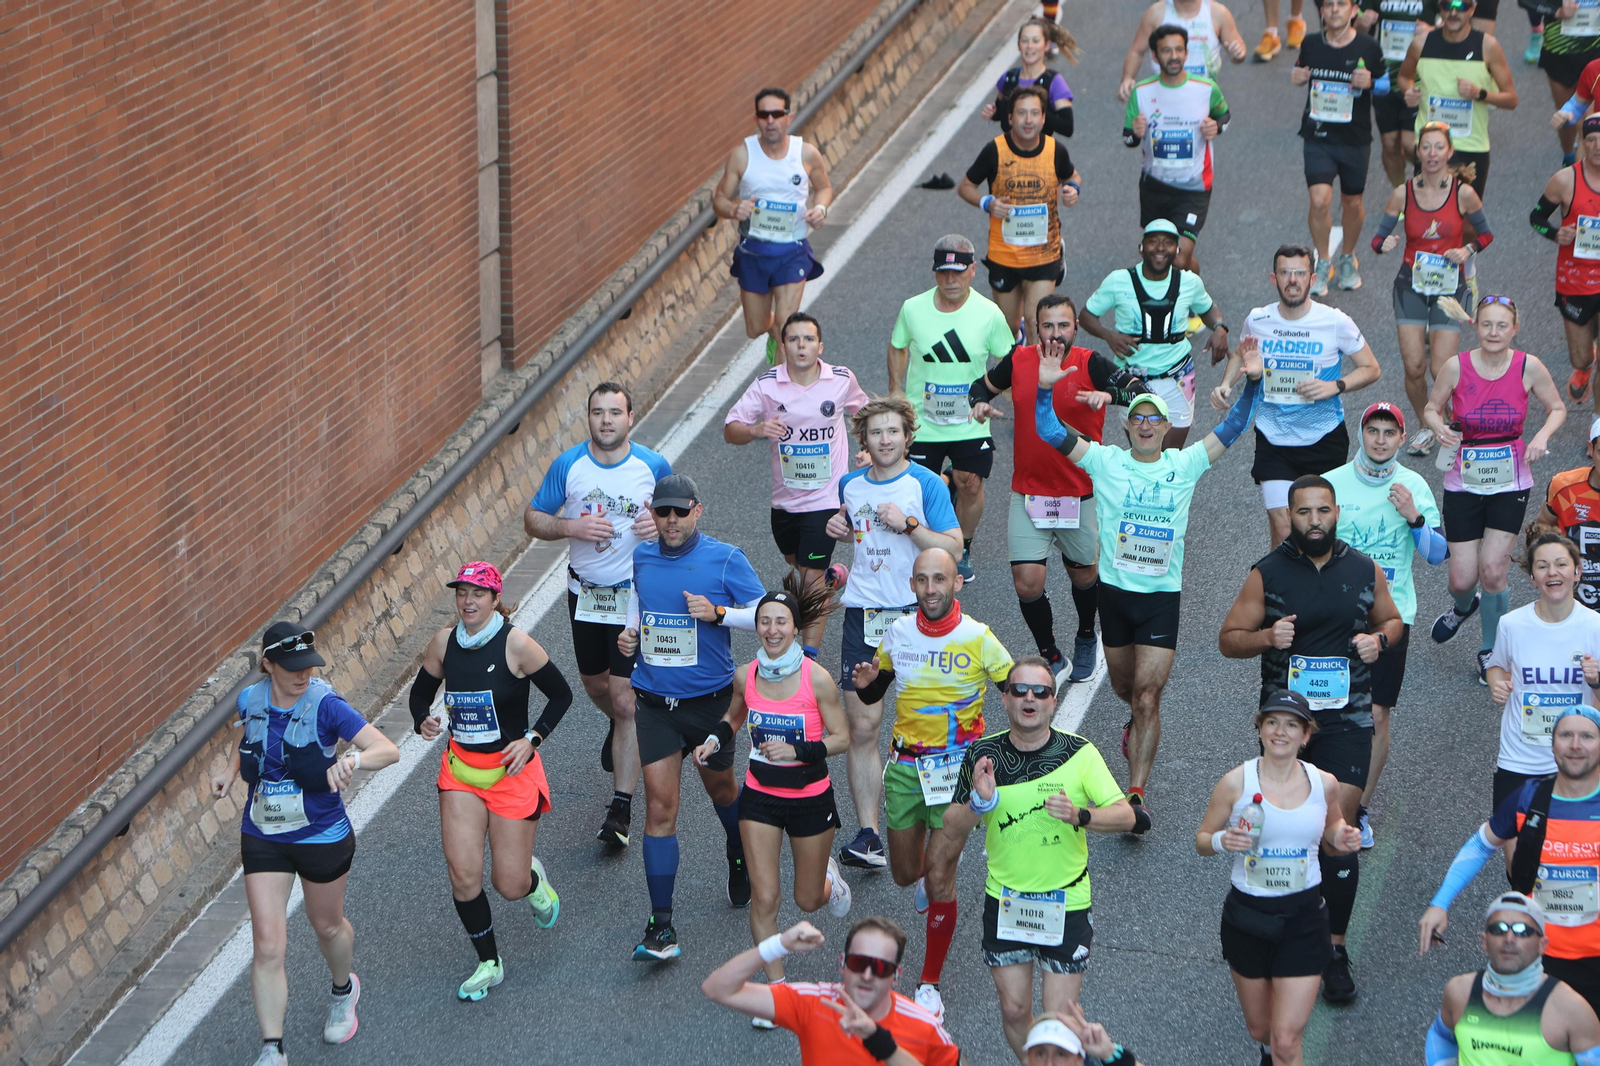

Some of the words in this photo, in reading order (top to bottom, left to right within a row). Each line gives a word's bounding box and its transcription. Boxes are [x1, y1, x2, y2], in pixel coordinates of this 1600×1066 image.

[1310, 67, 1353, 80] COSENTIN
[769, 202, 793, 211] ZURICH
[1018, 207, 1042, 216] ZURICH
[1278, 330, 1310, 338] Sabadell
[1262, 339, 1323, 357] MADRID
[1280, 361, 1307, 370] ZURICH
[1279, 376, 1295, 384] 9341
[938, 386, 964, 394] ZURICH
[1479, 417, 1518, 426] ROGUE
[1465, 424, 1514, 433] RUNNERS
[799, 426, 834, 441] XBTO
[796, 445, 824, 454] ZURICH
[1478, 450, 1507, 459] ZURICH
[795, 462, 815, 470] 10416
[1477, 466, 1499, 475] 10878
[794, 471, 816, 479] PENADO
[1480, 476, 1496, 484] CATH
[1044, 499, 1061, 507] 6855
[1123, 511, 1171, 524] SEVILLA'24
[1138, 527, 1168, 539] ZURICH
[1133, 543, 1156, 554] 11036
[1121, 553, 1138, 562] JUAN
[1138, 555, 1164, 565] ANTONIO
[596, 593, 616, 602] 10574
[593, 604, 617, 612] EMILIEN
[658, 615, 688, 626] ZURICH
[656, 635, 677, 644] 10431
[654, 646, 681, 655] BMANHA
[928, 650, 971, 675] TEJO
[1310, 660, 1341, 670] ZURICH
[1522, 666, 1583, 685] ELLIE
[1309, 679, 1329, 688] 4428
[1307, 690, 1331, 699] MOUNS
[456, 696, 485, 705] ZURICH
[1543, 696, 1577, 705] ZURICH
[460, 712, 479, 721] 12702
[765, 716, 796, 728] ZURICH
[939, 753, 964, 766] ZURIC
[264, 783, 294, 795] ZURICH
[930, 785, 949, 794] NUNO
[1267, 848, 1303, 857] ZURICH
[1265, 866, 1291, 876] 10773
[1552, 869, 1589, 879] ZURICH
[1265, 879, 1291, 888] ELOISE
[1024, 891, 1057, 900] ZURICH
[1552, 889, 1574, 900] 9882
[1545, 902, 1584, 912] JABERSON
[1020, 907, 1044, 918] 11018
[1016, 919, 1046, 931] MICHAEL
